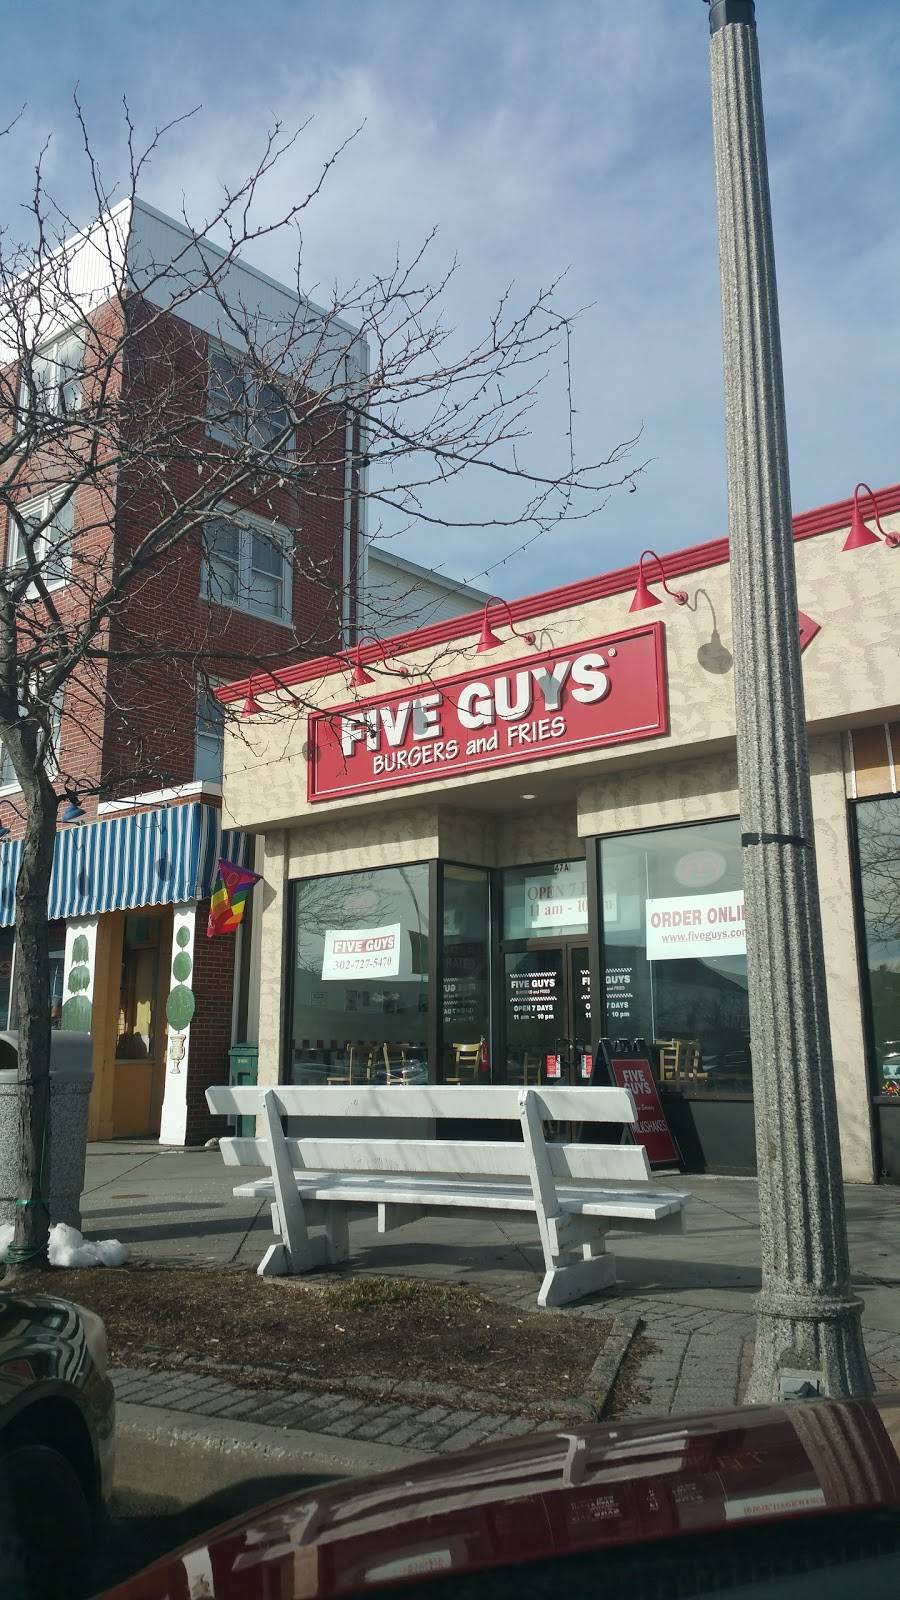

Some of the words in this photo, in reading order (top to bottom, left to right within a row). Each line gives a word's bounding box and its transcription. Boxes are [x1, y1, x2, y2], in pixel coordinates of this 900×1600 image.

[341, 693, 443, 757] FIVE
[457, 653, 610, 729] GUYS
[373, 740, 459, 775] BURGERS
[466, 729, 498, 756] and
[507, 716, 567, 747] FRIES
[527, 884, 563, 901] OPEN
[569, 882, 577, 897] 7
[530, 903, 540, 917] 11
[544, 905, 563, 916] am
[651, 909, 702, 928] ORDER
[334, 940, 363, 953] FIVE
[365, 936, 394, 951] GUYS
[333, 956, 392, 970] 302-727-5470
[511, 980, 530, 989] FIVE
[531, 979, 556, 988] GUYS
[581, 976, 591, 986] FI
[605, 975, 631, 984] GUYS
[513, 1004, 531, 1012] OPEN
[610, 1001, 629, 1009] DAYS
[620, 1011, 630, 1019] pm
[622, 1070, 646, 1082] FIVE
